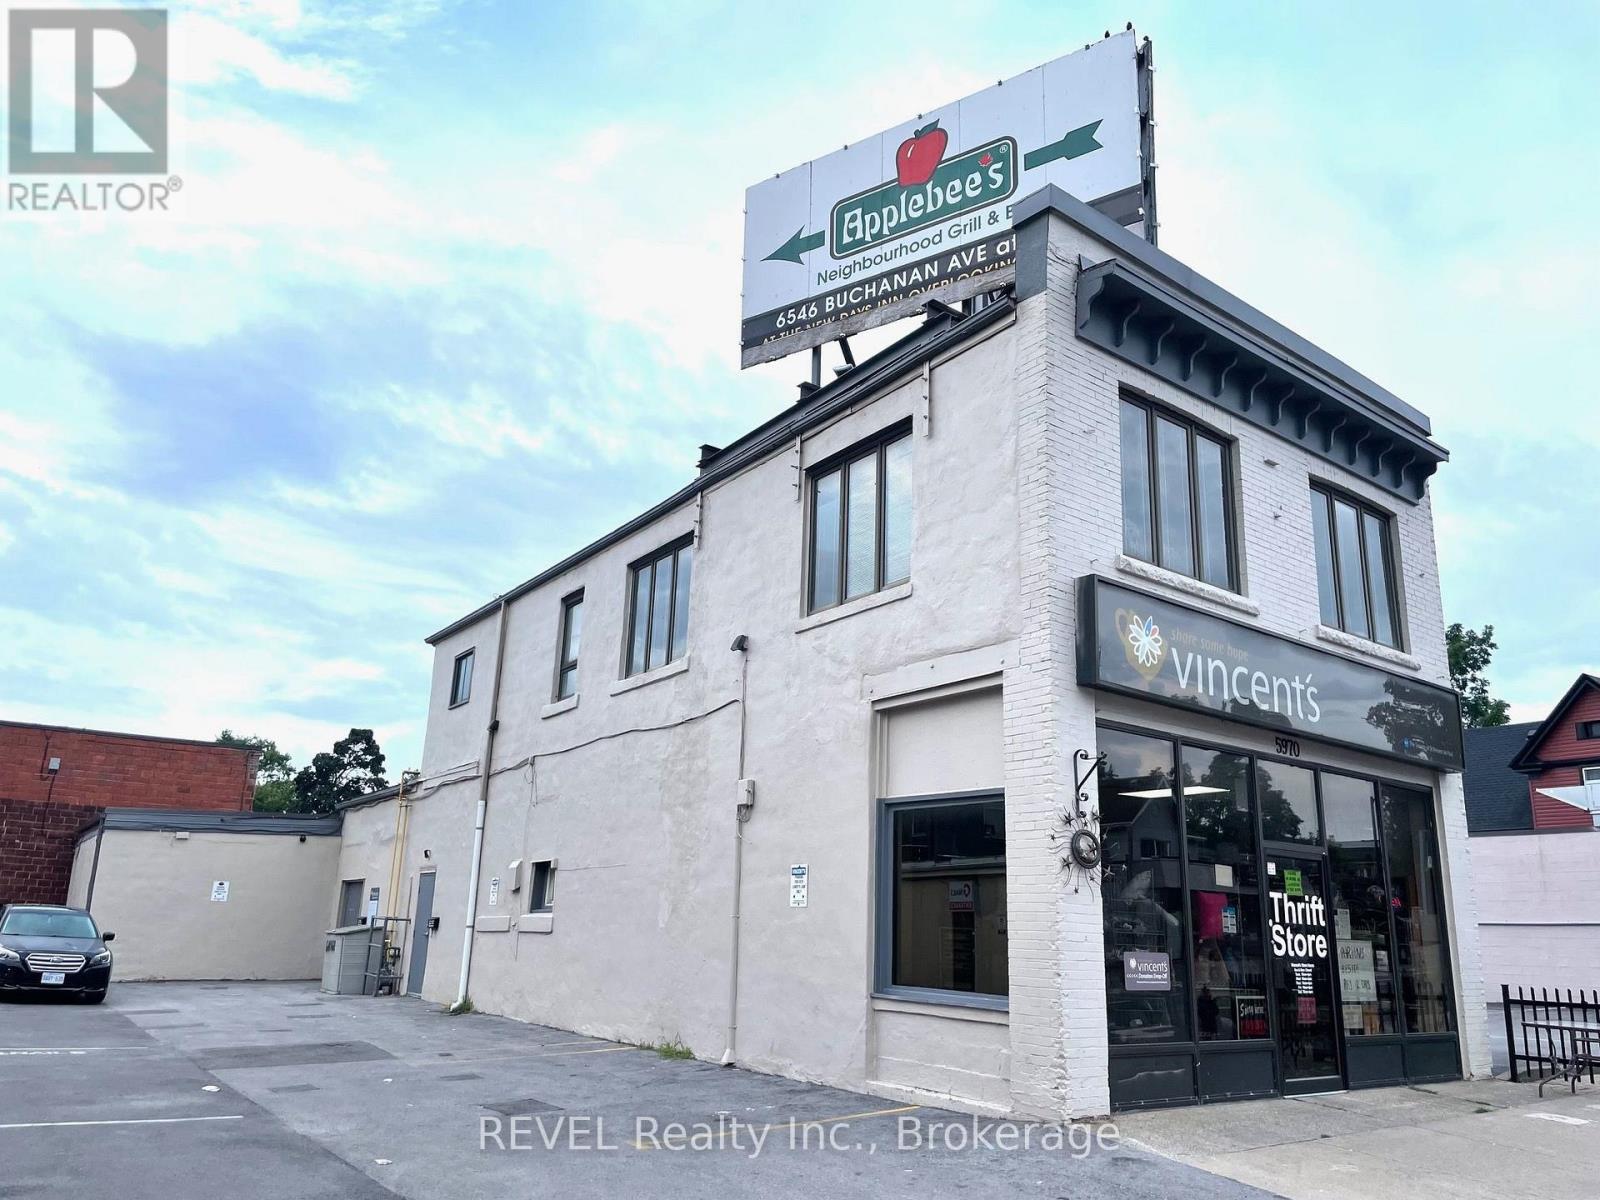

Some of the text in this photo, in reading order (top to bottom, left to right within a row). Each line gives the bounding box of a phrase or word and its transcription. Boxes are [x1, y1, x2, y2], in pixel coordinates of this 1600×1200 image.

[842, 161, 1004, 246] Applebee's
[775, 302, 819, 329] 6546
[825, 260, 939, 313] BUCHANAN
[947, 243, 988, 273] AVE
[816, 229, 943, 286] Neighbourhood
[947, 215, 982, 239] Grill
[987, 210, 1000, 226] &
[1171, 646, 1322, 723] vincent's
[1275, 736, 1300, 757] 5970
[1269, 891, 1326, 927] Thrift
[1271, 924, 1328, 958] Store
